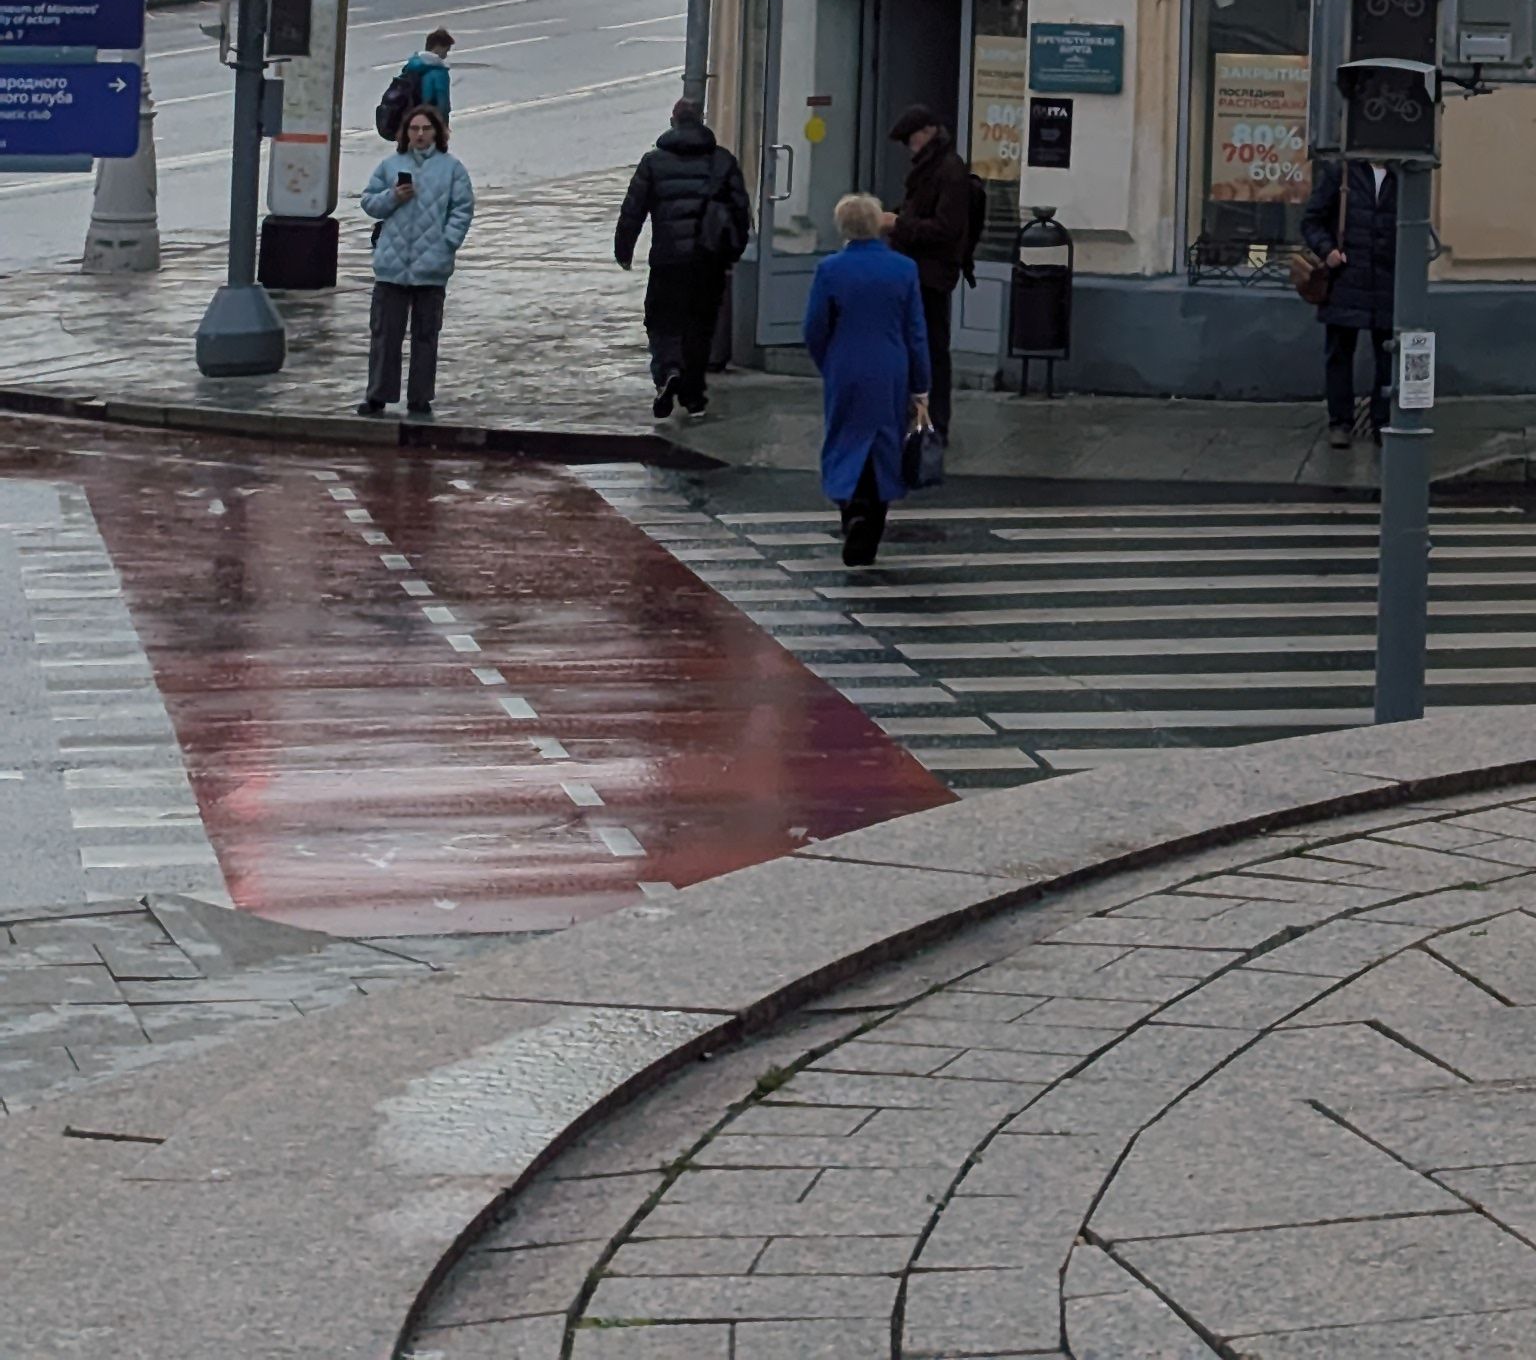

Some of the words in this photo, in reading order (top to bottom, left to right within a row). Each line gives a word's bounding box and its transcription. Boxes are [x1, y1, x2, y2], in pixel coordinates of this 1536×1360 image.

[1231, 123, 1304, 150] 80%
[1222, 143, 1279, 164] 70%
[1249, 161, 1304, 181] 60%
